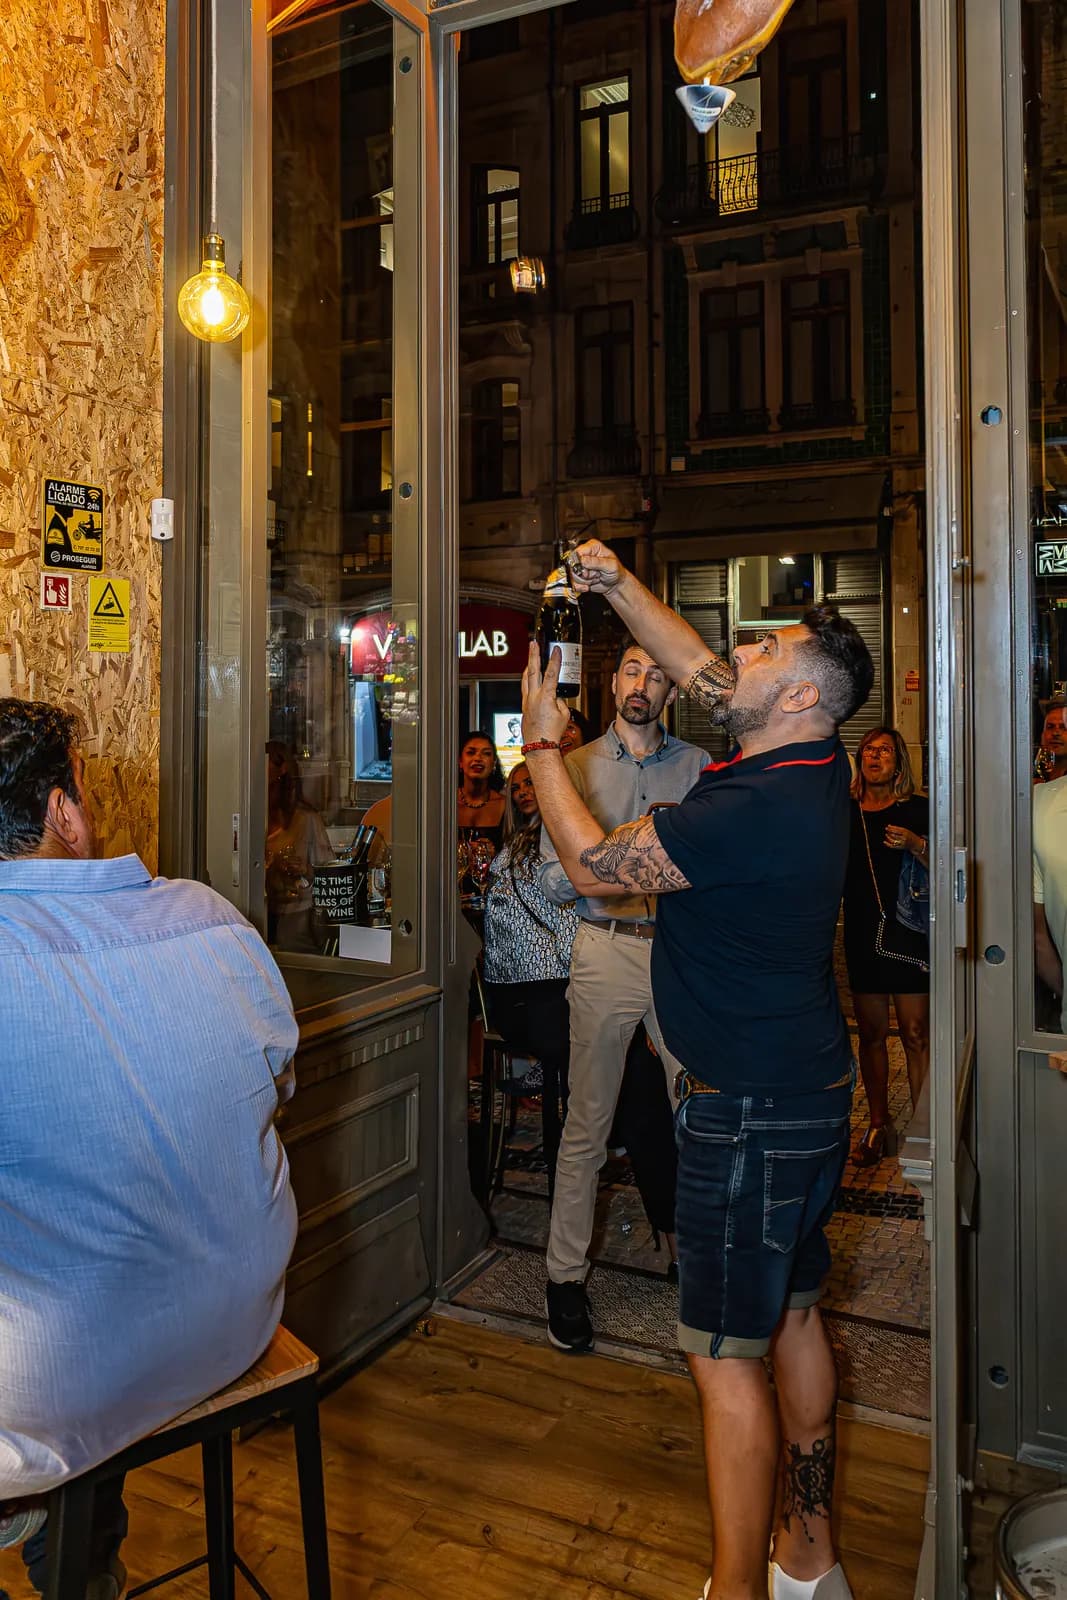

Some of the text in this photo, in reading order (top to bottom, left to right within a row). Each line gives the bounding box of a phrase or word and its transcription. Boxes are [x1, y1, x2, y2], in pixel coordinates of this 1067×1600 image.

[48, 482, 86, 496] ALARME
[47, 491, 86, 505] LIGADO
[62, 554, 97, 565] PROSEGUR
[328, 875, 353, 885] TIME
[328, 886, 354, 896] NICE
[339, 896, 354, 906] OF
[327, 907, 354, 918] WINE
